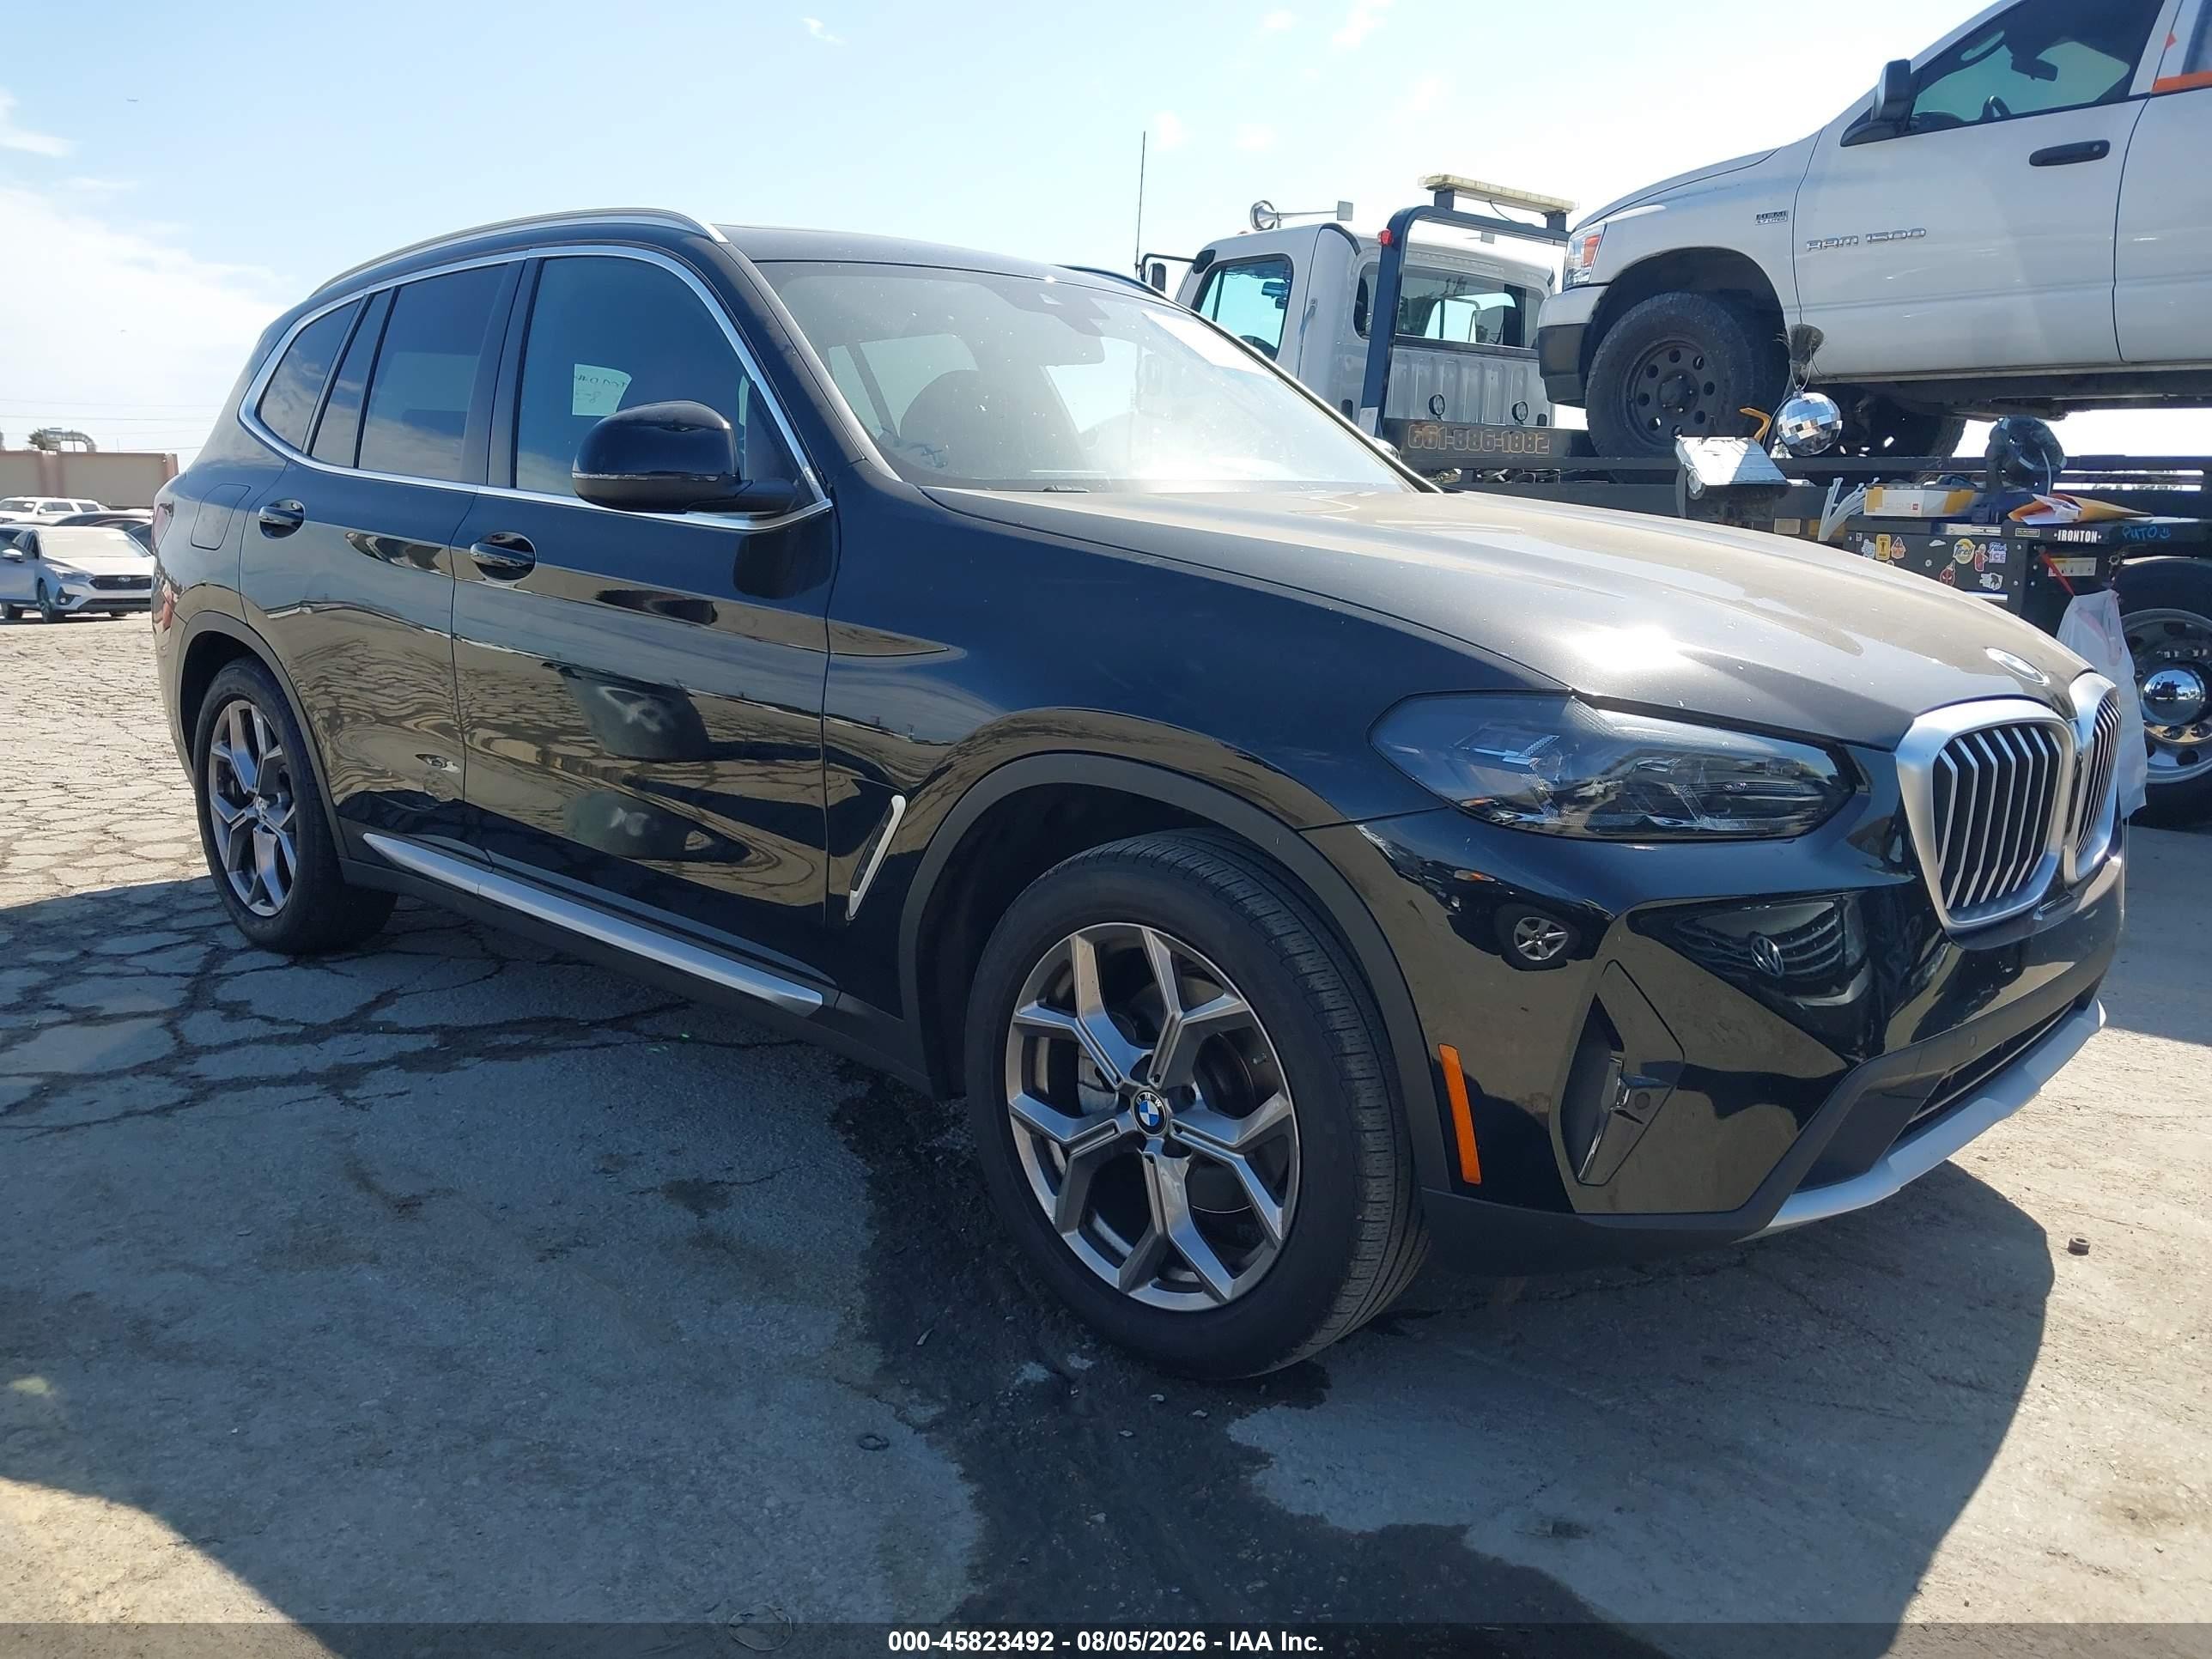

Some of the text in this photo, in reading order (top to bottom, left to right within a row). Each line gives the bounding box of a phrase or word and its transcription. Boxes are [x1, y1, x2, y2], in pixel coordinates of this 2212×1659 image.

[1866, 228, 1927, 244] 1500
[1408, 424, 1550, 454] 661-886-1882
[2057, 529, 2098, 544] IRONTON
